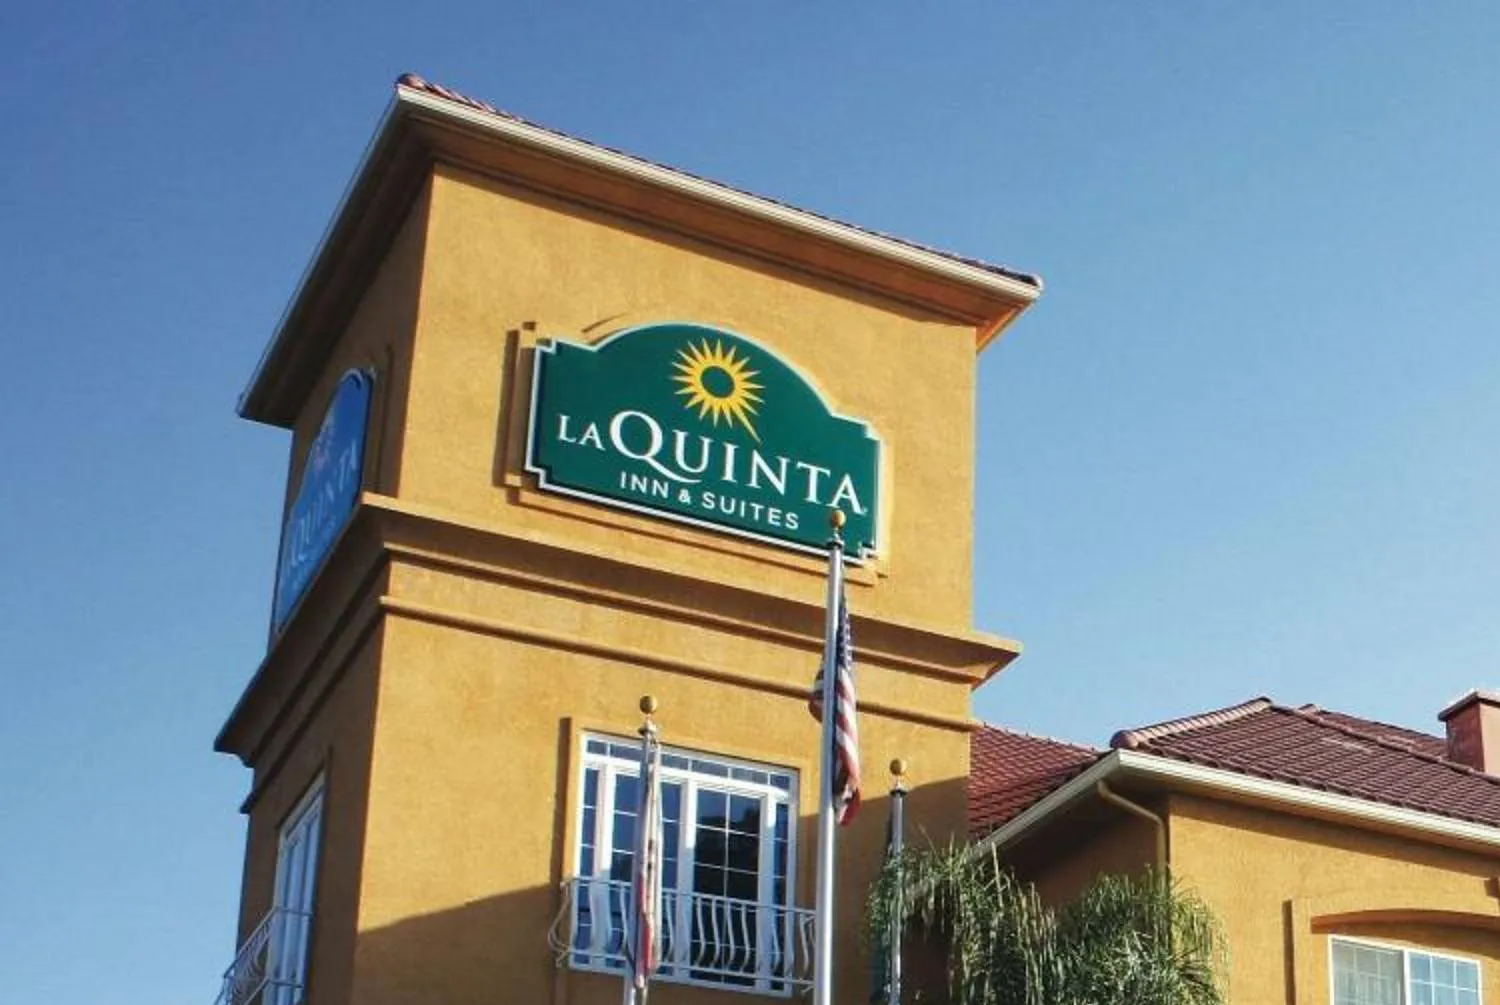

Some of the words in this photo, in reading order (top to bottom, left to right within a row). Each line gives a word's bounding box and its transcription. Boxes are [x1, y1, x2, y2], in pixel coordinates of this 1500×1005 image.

[558, 415, 605, 451] LA
[610, 410, 865, 516] QUINTA
[620, 471, 669, 500] INN
[678, 489, 692, 505] &
[702, 491, 801, 530] SUITES
